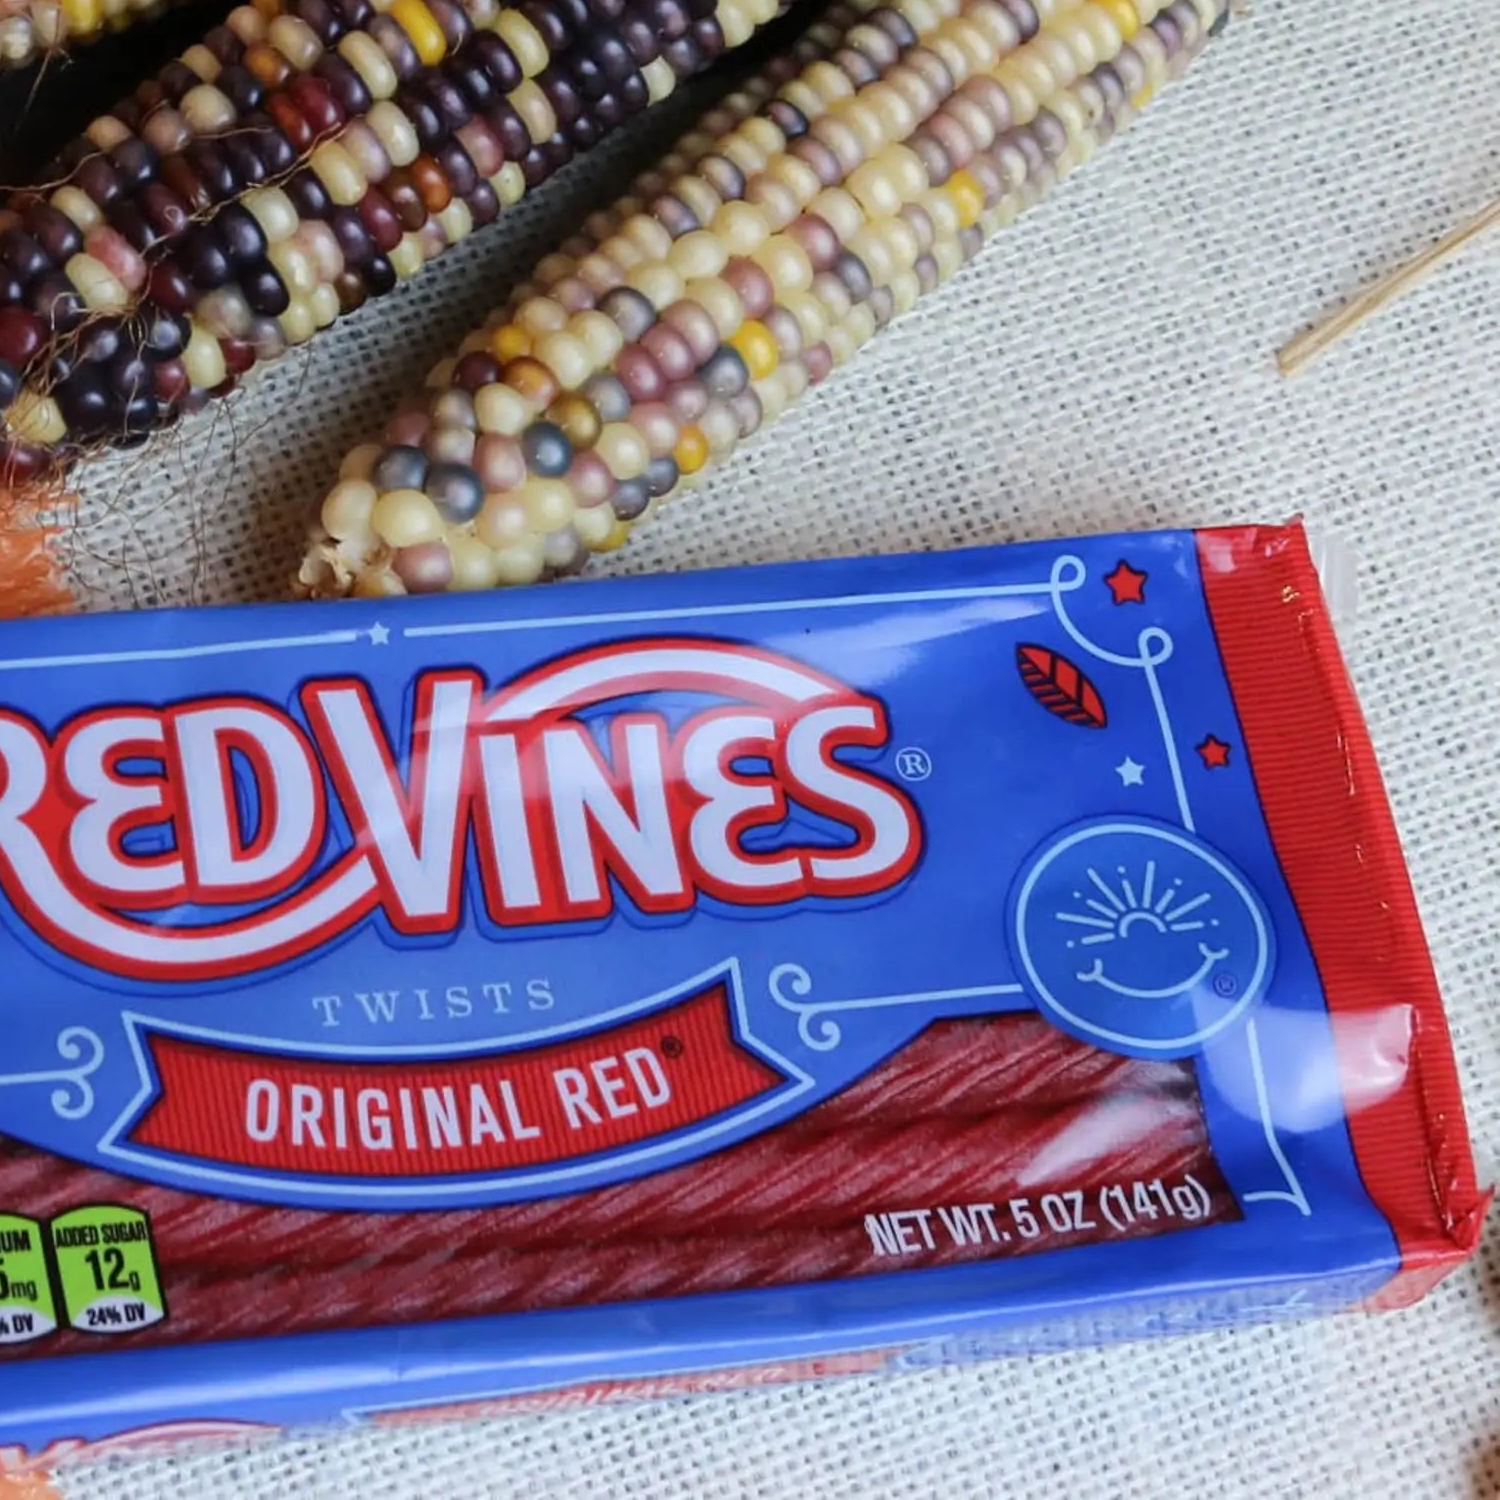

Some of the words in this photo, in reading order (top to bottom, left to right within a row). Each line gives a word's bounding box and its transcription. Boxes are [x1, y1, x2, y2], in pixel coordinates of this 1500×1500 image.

[312, 979, 555, 1027] TWISTS
[245, 1078, 541, 1151] ORIGINAL
[864, 1209, 936, 1256] NET
[937, 1204, 1011, 1246] WT.
[1009, 1199, 1040, 1239] 5
[1041, 1190, 1097, 1232] OZ
[1099, 1174, 1212, 1231] (141g)
[55, 1225, 99, 1248] ADDED
[101, 1221, 148, 1243] SUGAR
[12, 1313, 33, 1332] DV
[86, 1306, 122, 1326] 24%
[124, 1302, 145, 1322] DV
